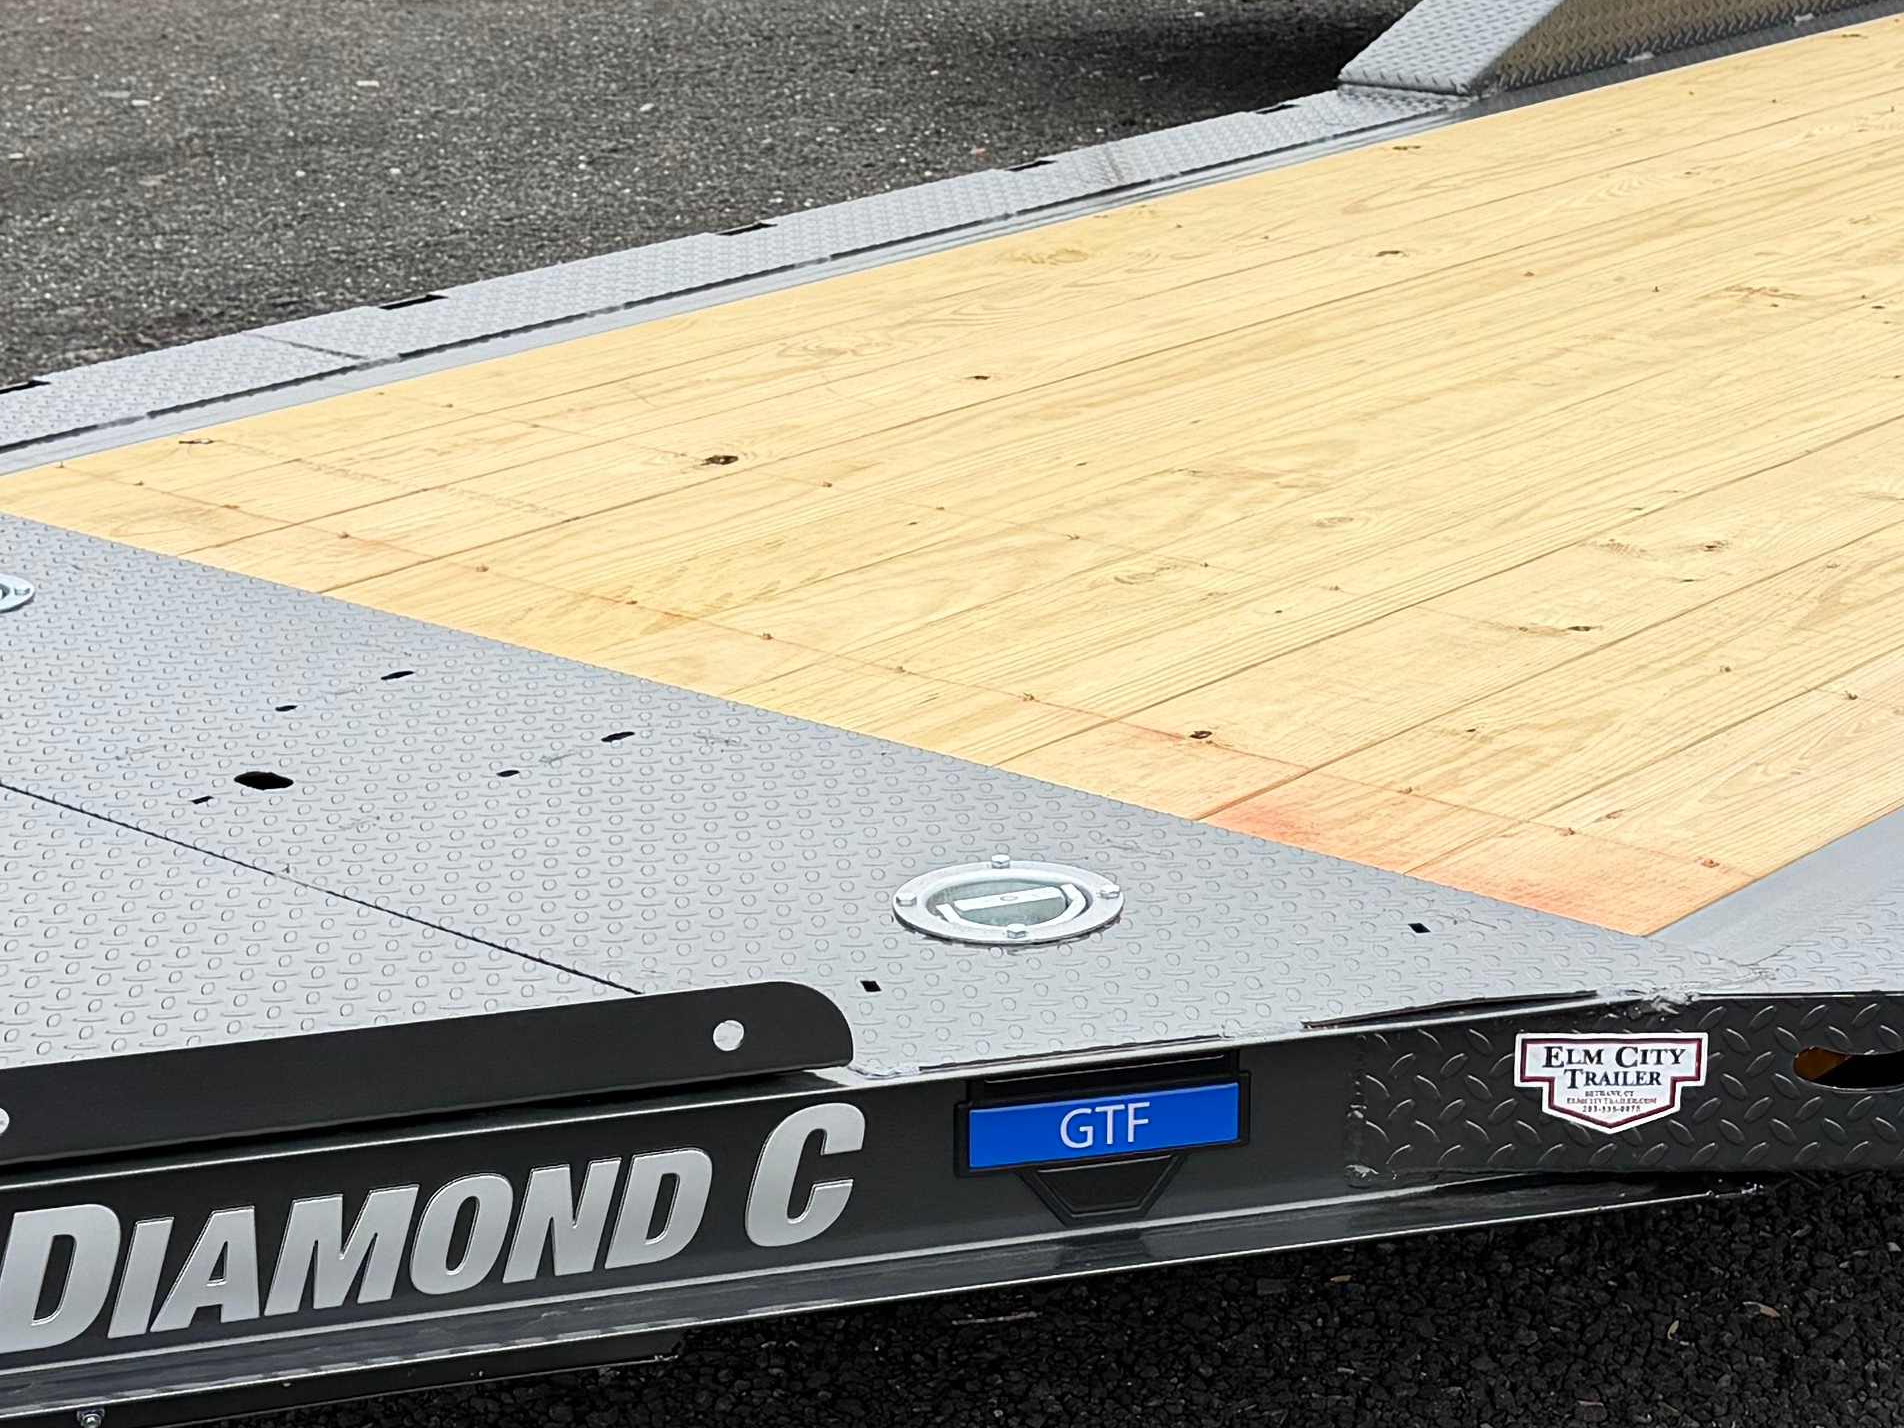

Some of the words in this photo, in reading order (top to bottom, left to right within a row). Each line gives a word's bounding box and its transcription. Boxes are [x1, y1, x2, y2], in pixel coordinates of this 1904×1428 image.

[1542, 1046, 1604, 1068] ELM
[1615, 1046, 1687, 1068] CITY
[1563, 1069, 1662, 1089] TRAILER
[1060, 1101, 1151, 1149] GTF
[744, 1101, 865, 1249] C
